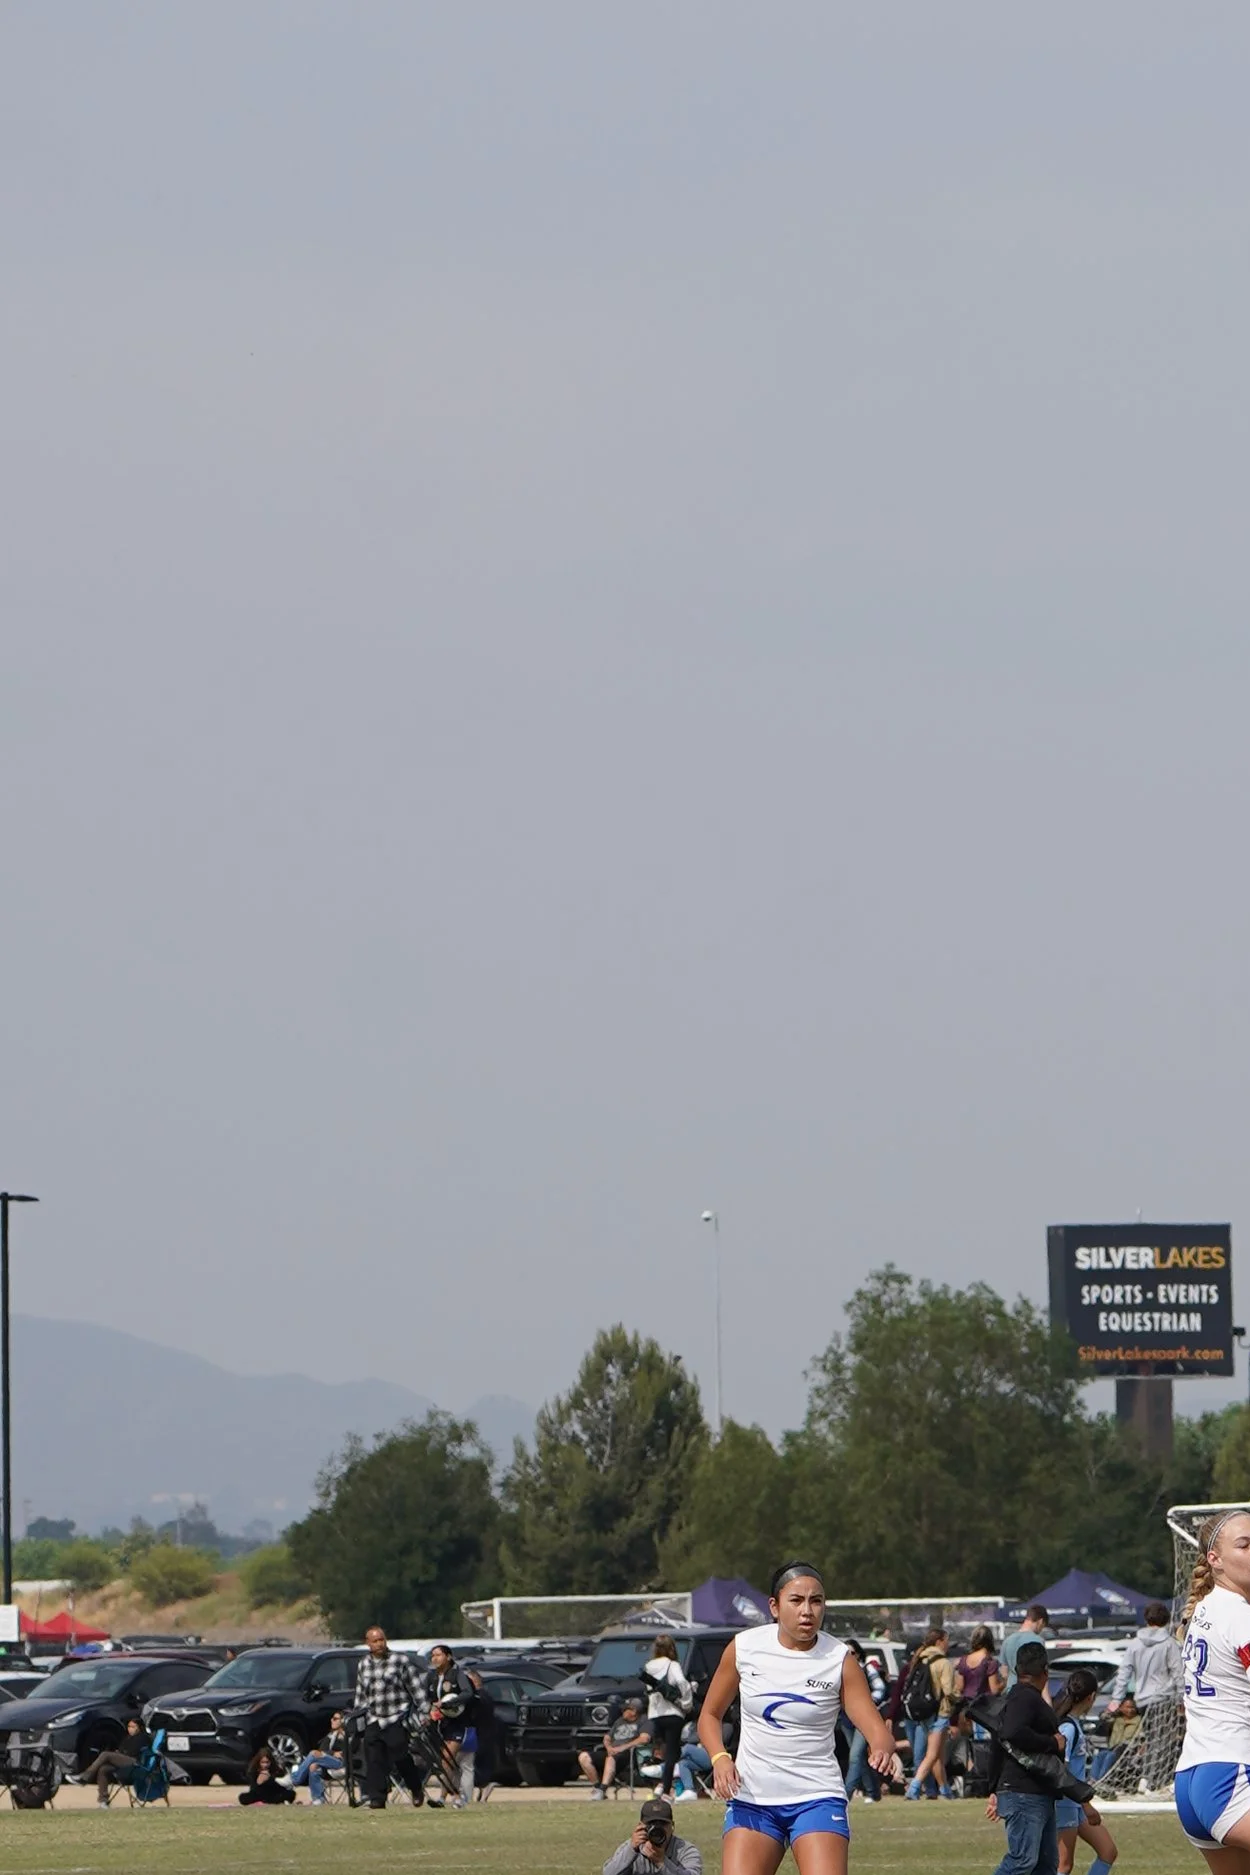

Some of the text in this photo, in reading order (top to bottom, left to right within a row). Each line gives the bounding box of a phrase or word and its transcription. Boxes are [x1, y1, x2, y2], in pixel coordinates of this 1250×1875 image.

[1074, 1246, 1226, 1270] SILVERLAKES
[1081, 1284, 1219, 1304] SPORTS EVENTS
[1099, 1312, 1202, 1331] EQUESTRIAN
[805, 1679, 833, 1690] SURF
